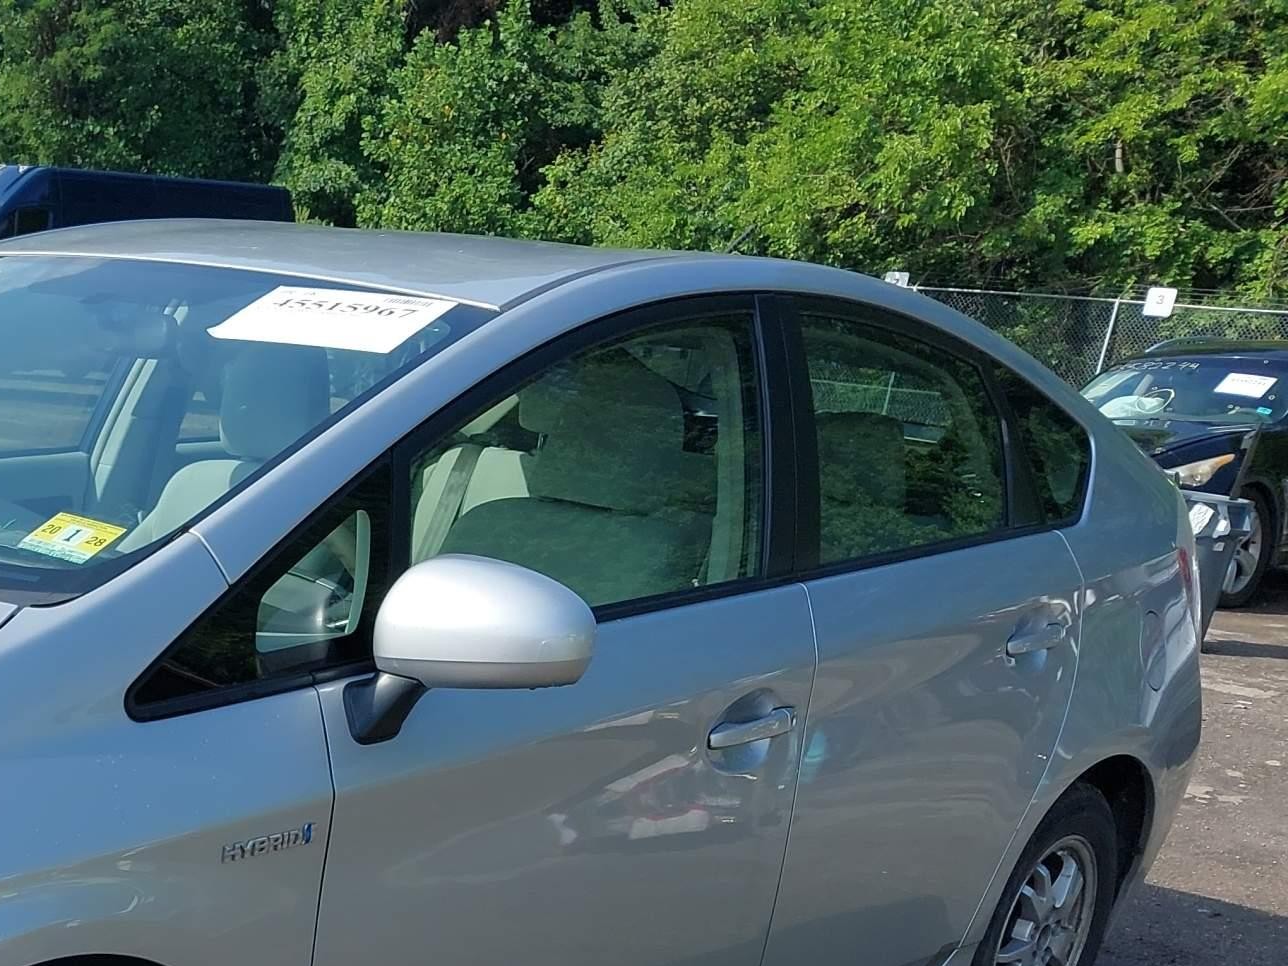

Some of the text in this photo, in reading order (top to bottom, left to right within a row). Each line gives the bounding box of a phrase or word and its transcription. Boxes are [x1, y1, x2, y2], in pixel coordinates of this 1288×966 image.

[273, 298, 419, 318] 45515967
[1155, 294, 1165, 305] 3
[41, 524, 62, 534] 20
[85, 536, 107, 547] 28
[220, 829, 300, 864] HYBRID
